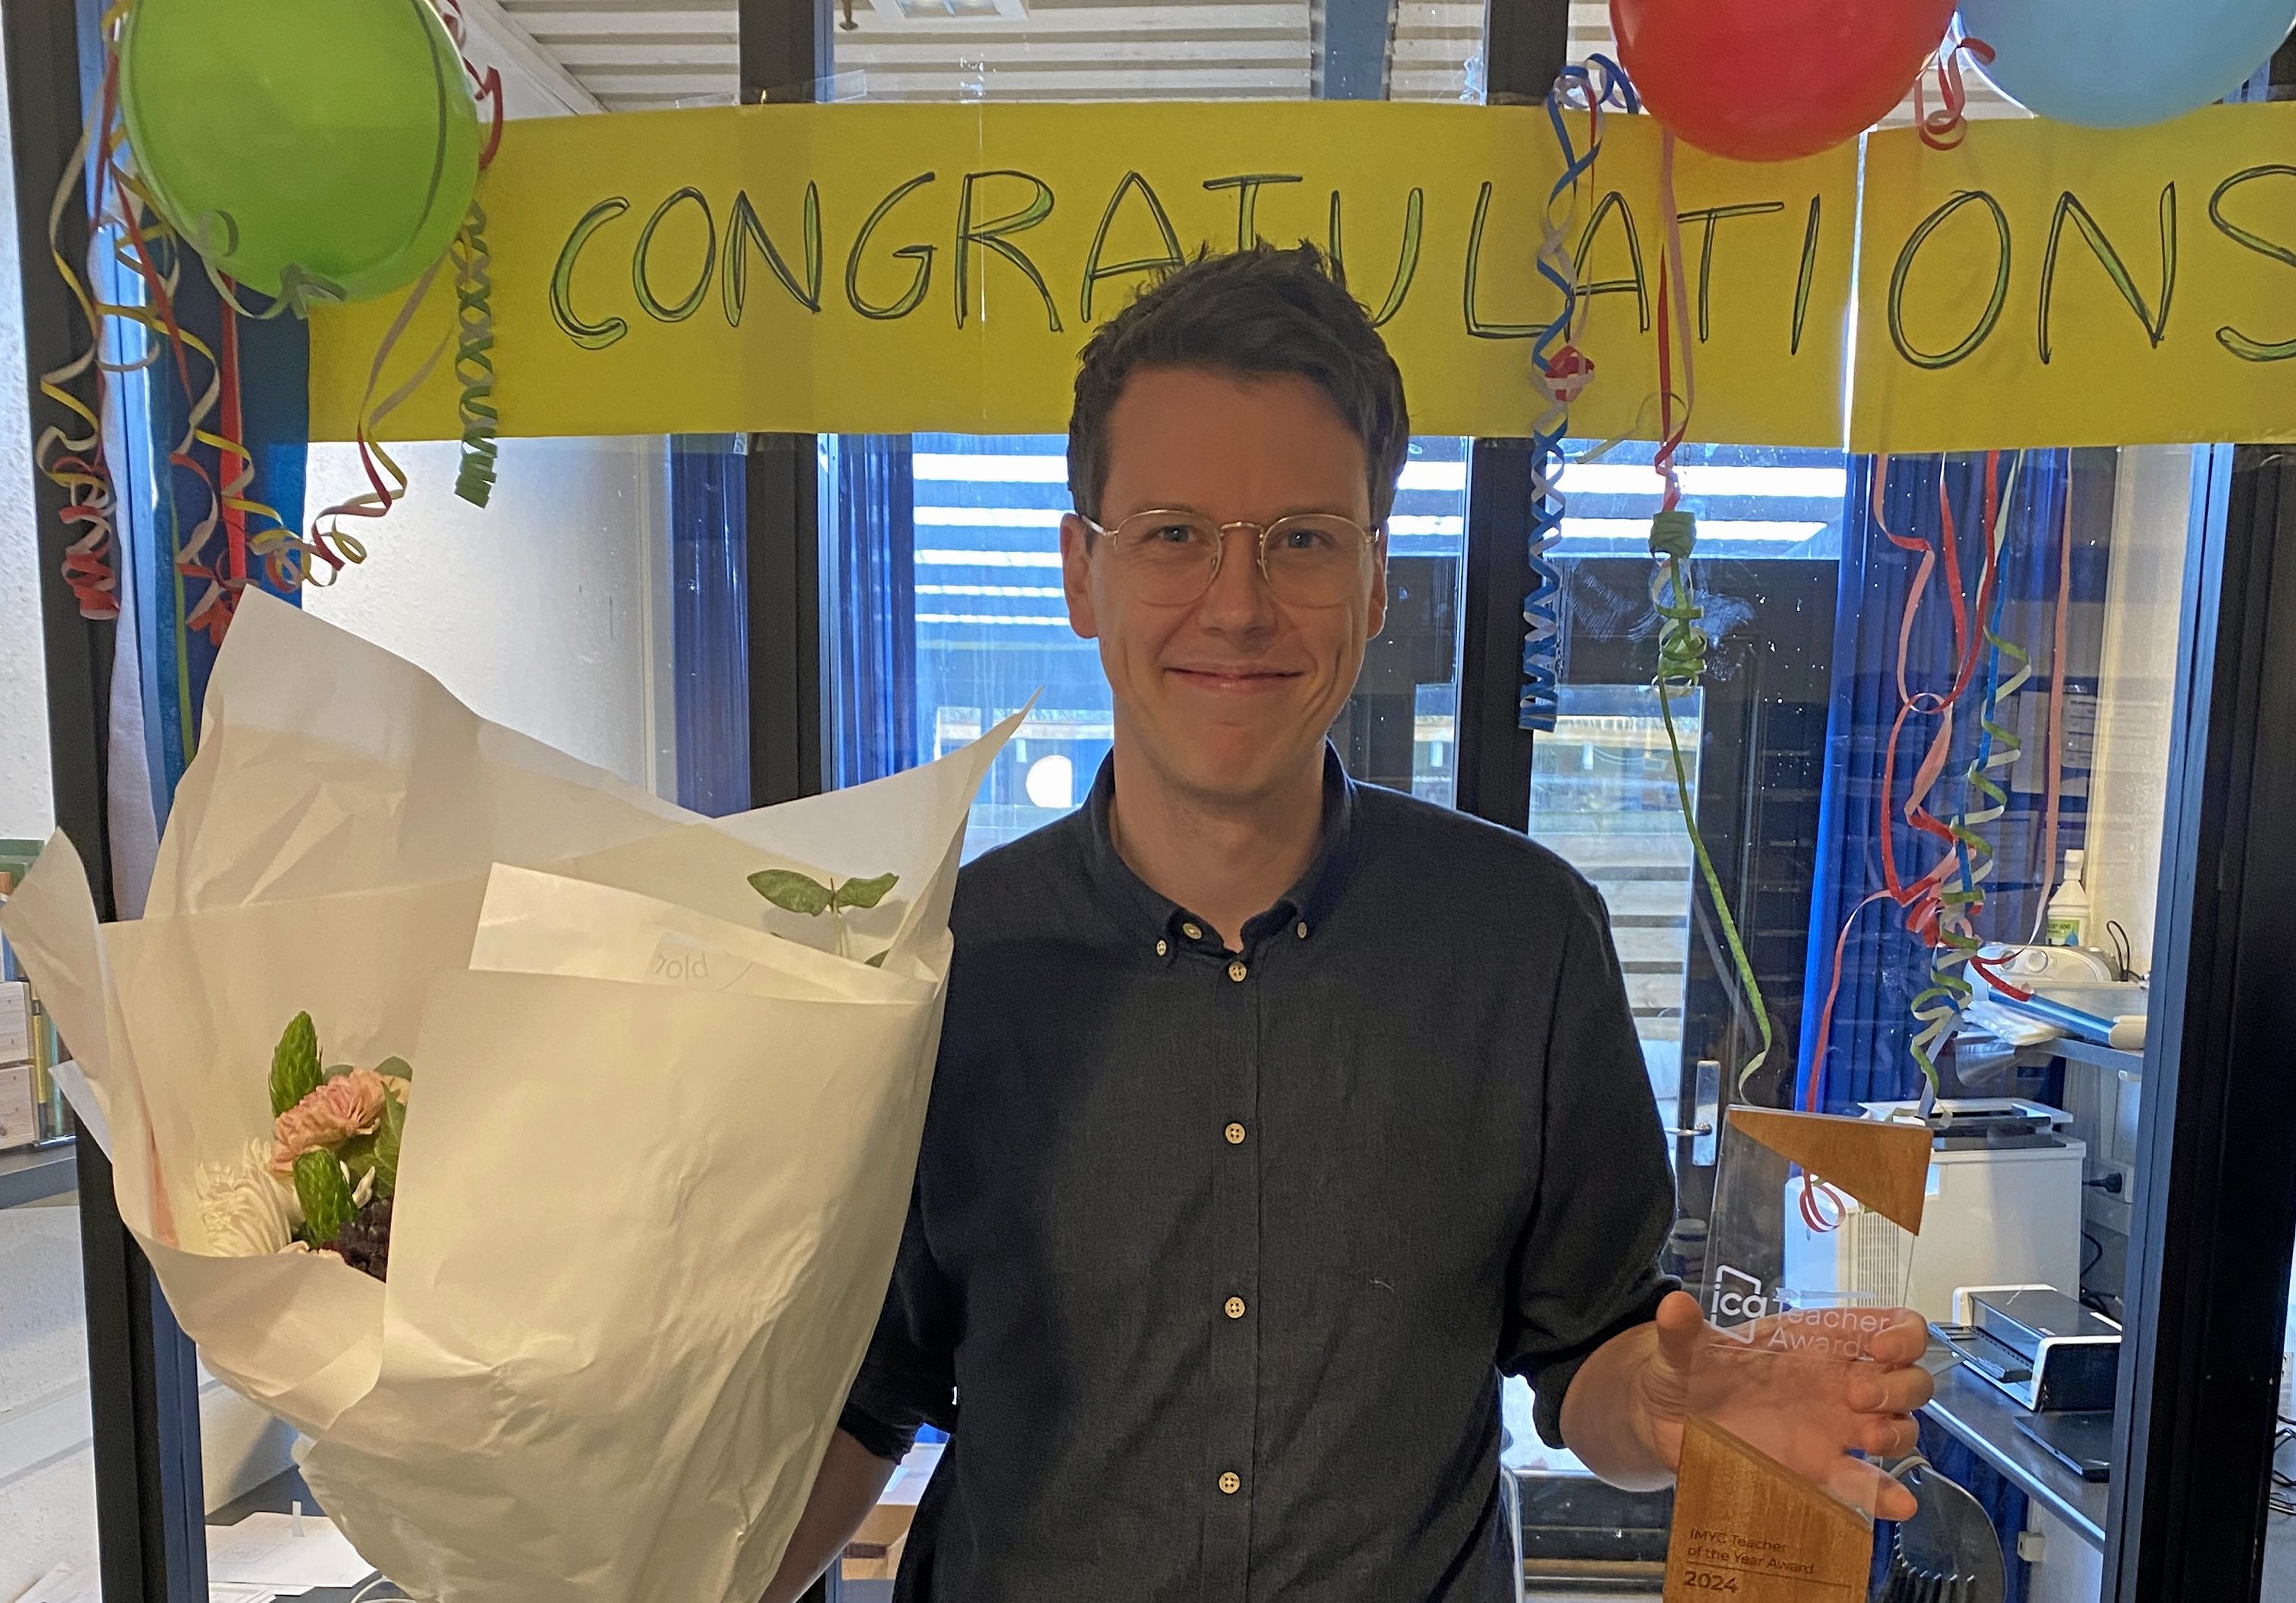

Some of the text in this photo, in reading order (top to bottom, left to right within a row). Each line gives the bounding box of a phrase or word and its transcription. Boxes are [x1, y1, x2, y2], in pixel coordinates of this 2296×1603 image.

[1773, 1298, 1890, 1332] Teacher
[1690, 1528, 1787, 1552] IMYC Teacher
[1688, 1546, 1814, 1575] of the Year Award
[1684, 1571, 1738, 1593] 2024
